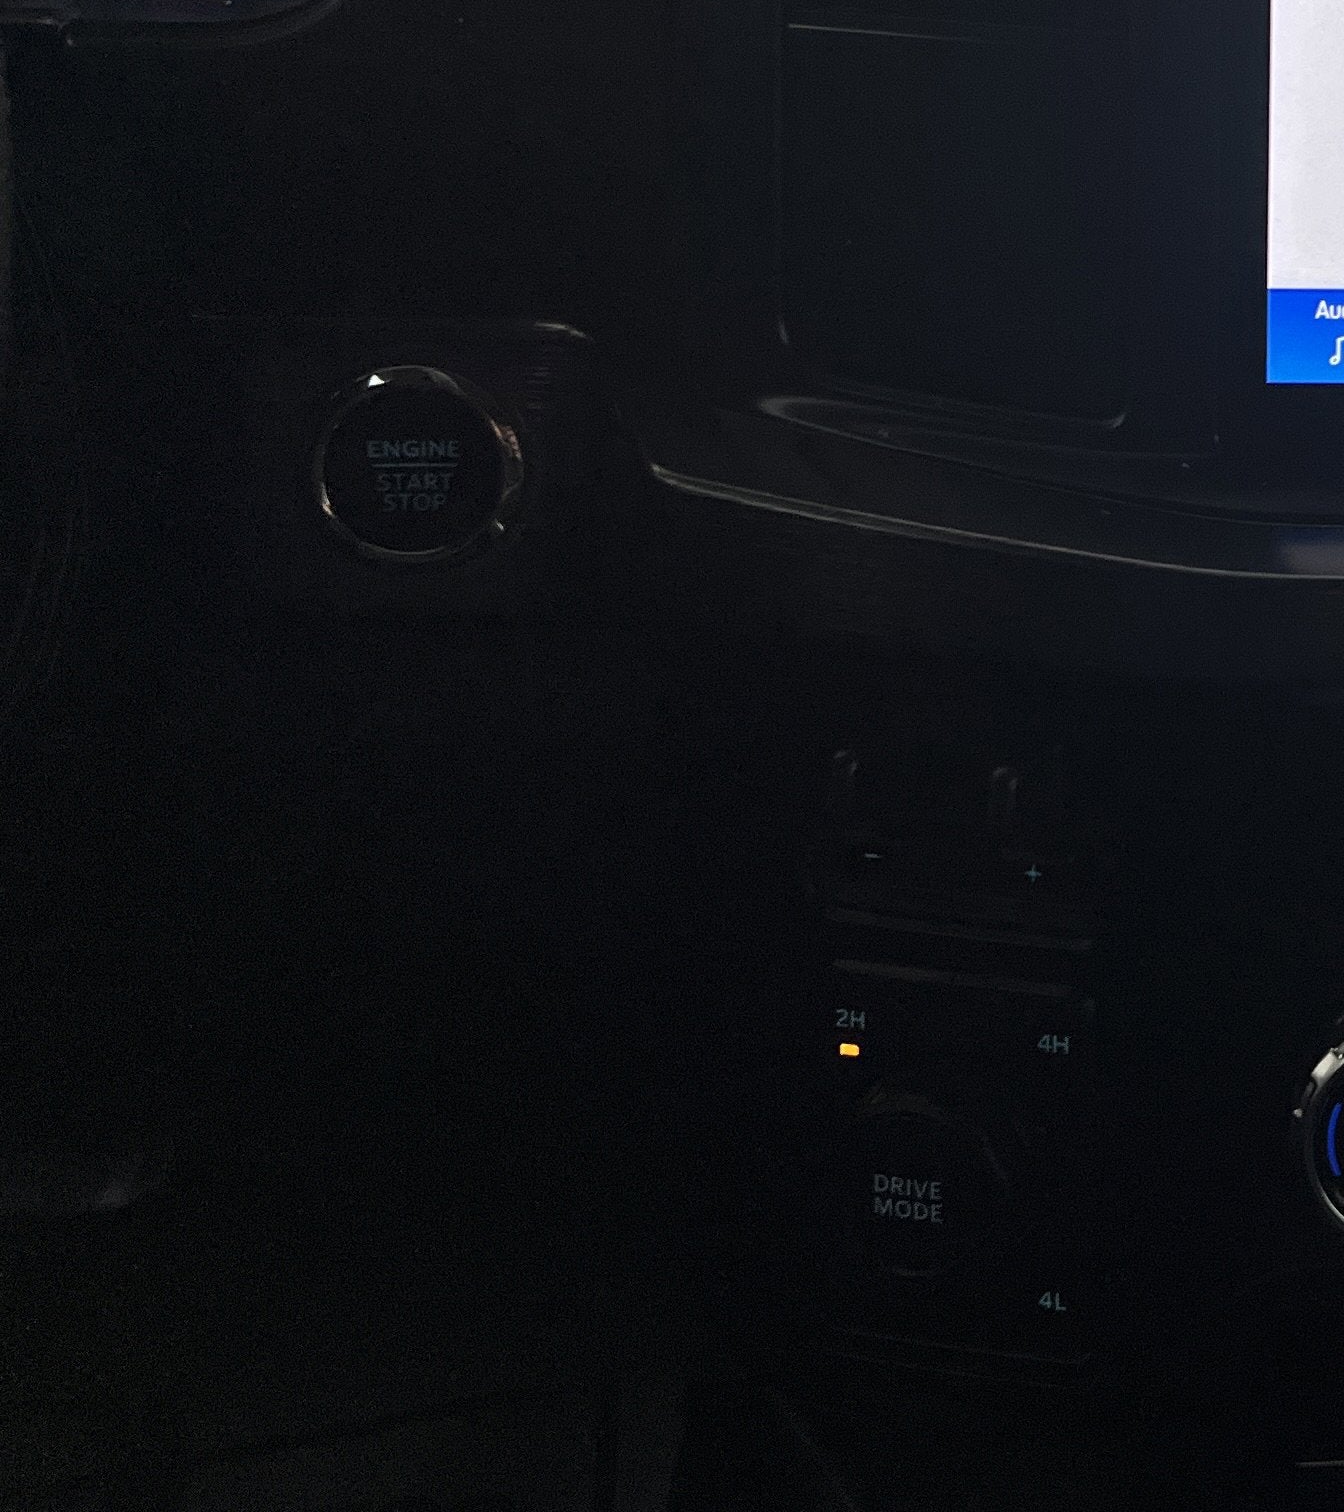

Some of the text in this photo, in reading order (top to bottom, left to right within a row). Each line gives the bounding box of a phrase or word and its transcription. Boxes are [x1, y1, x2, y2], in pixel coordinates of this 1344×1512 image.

[367, 440, 459, 458] ENGINE
[376, 472, 451, 491] START
[383, 493, 447, 512] STOP
[835, 1008, 866, 1032] 2H
[1037, 1033, 1070, 1056] 4H
[873, 1172, 943, 1202] DRIVE
[872, 1196, 944, 1224] MODE
[1037, 1291, 1068, 1313] 4L
